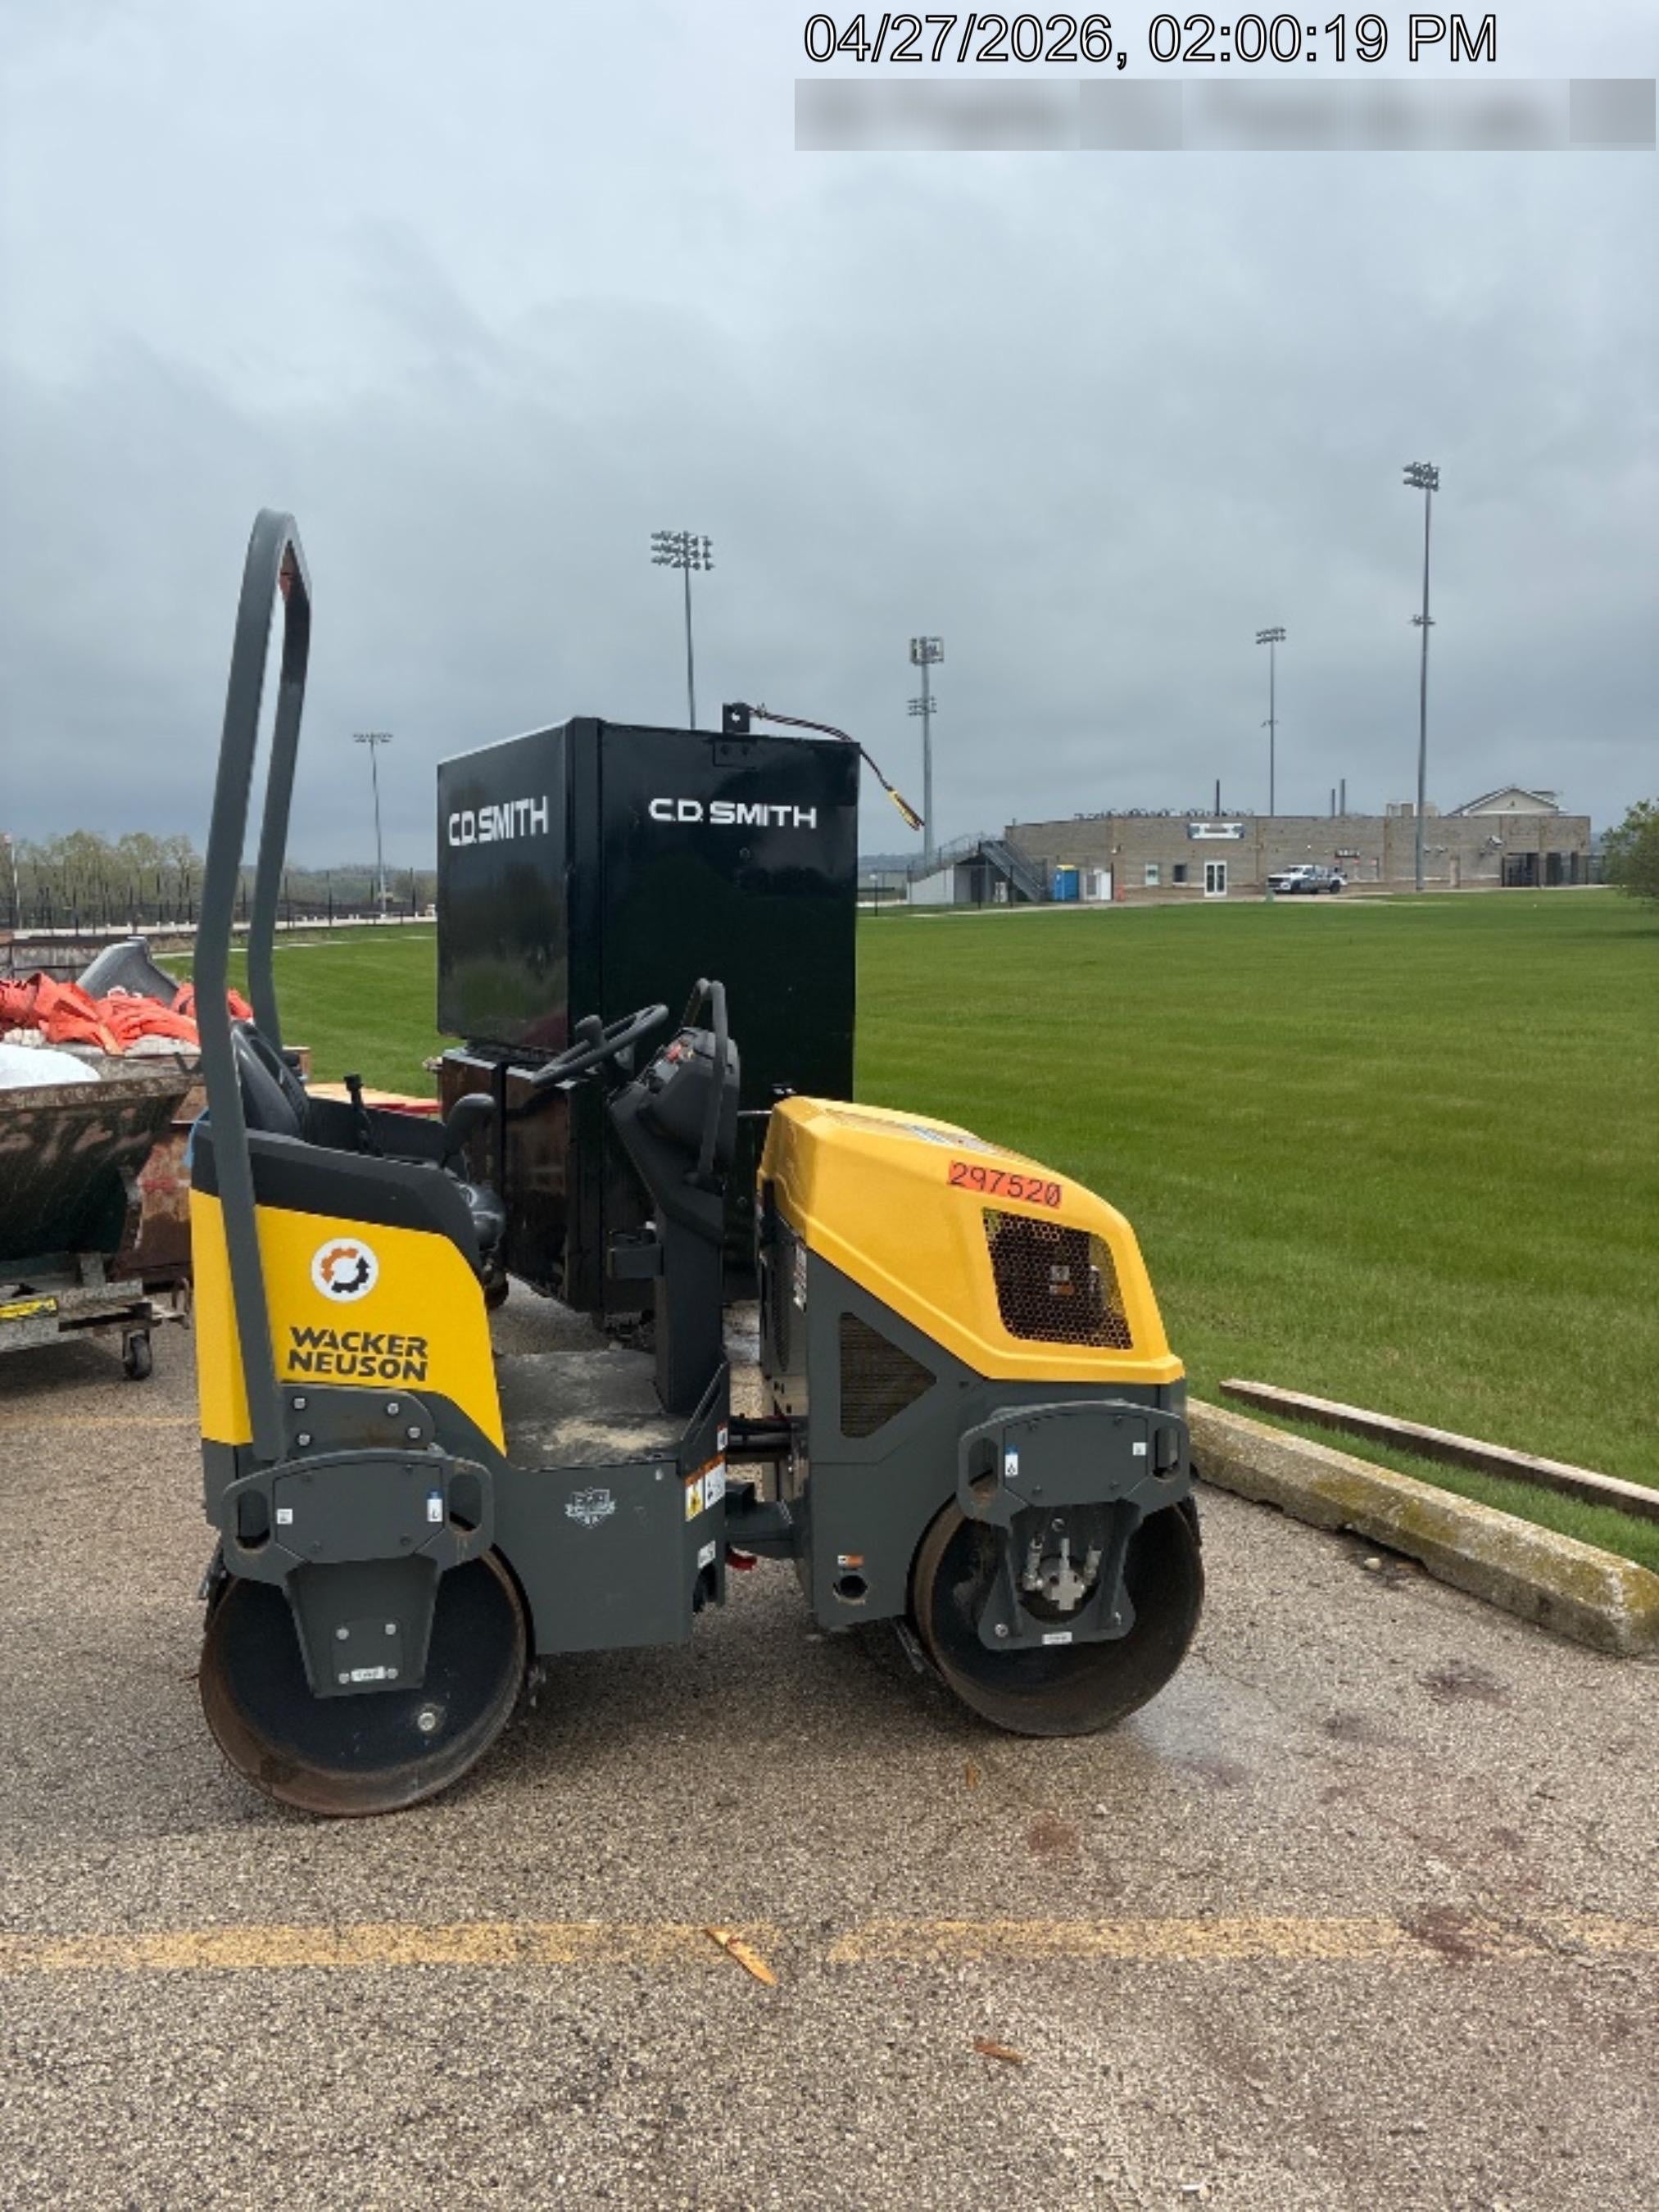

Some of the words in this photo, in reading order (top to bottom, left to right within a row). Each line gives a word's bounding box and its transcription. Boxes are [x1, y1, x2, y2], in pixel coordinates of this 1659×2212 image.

[478, 796, 548, 843] SMITH
[709, 800, 817, 830] SMITH
[950, 1161, 1062, 1208] 297520
[289, 1326, 428, 1359] WACKER
[288, 1349, 428, 1382] NEUSON
